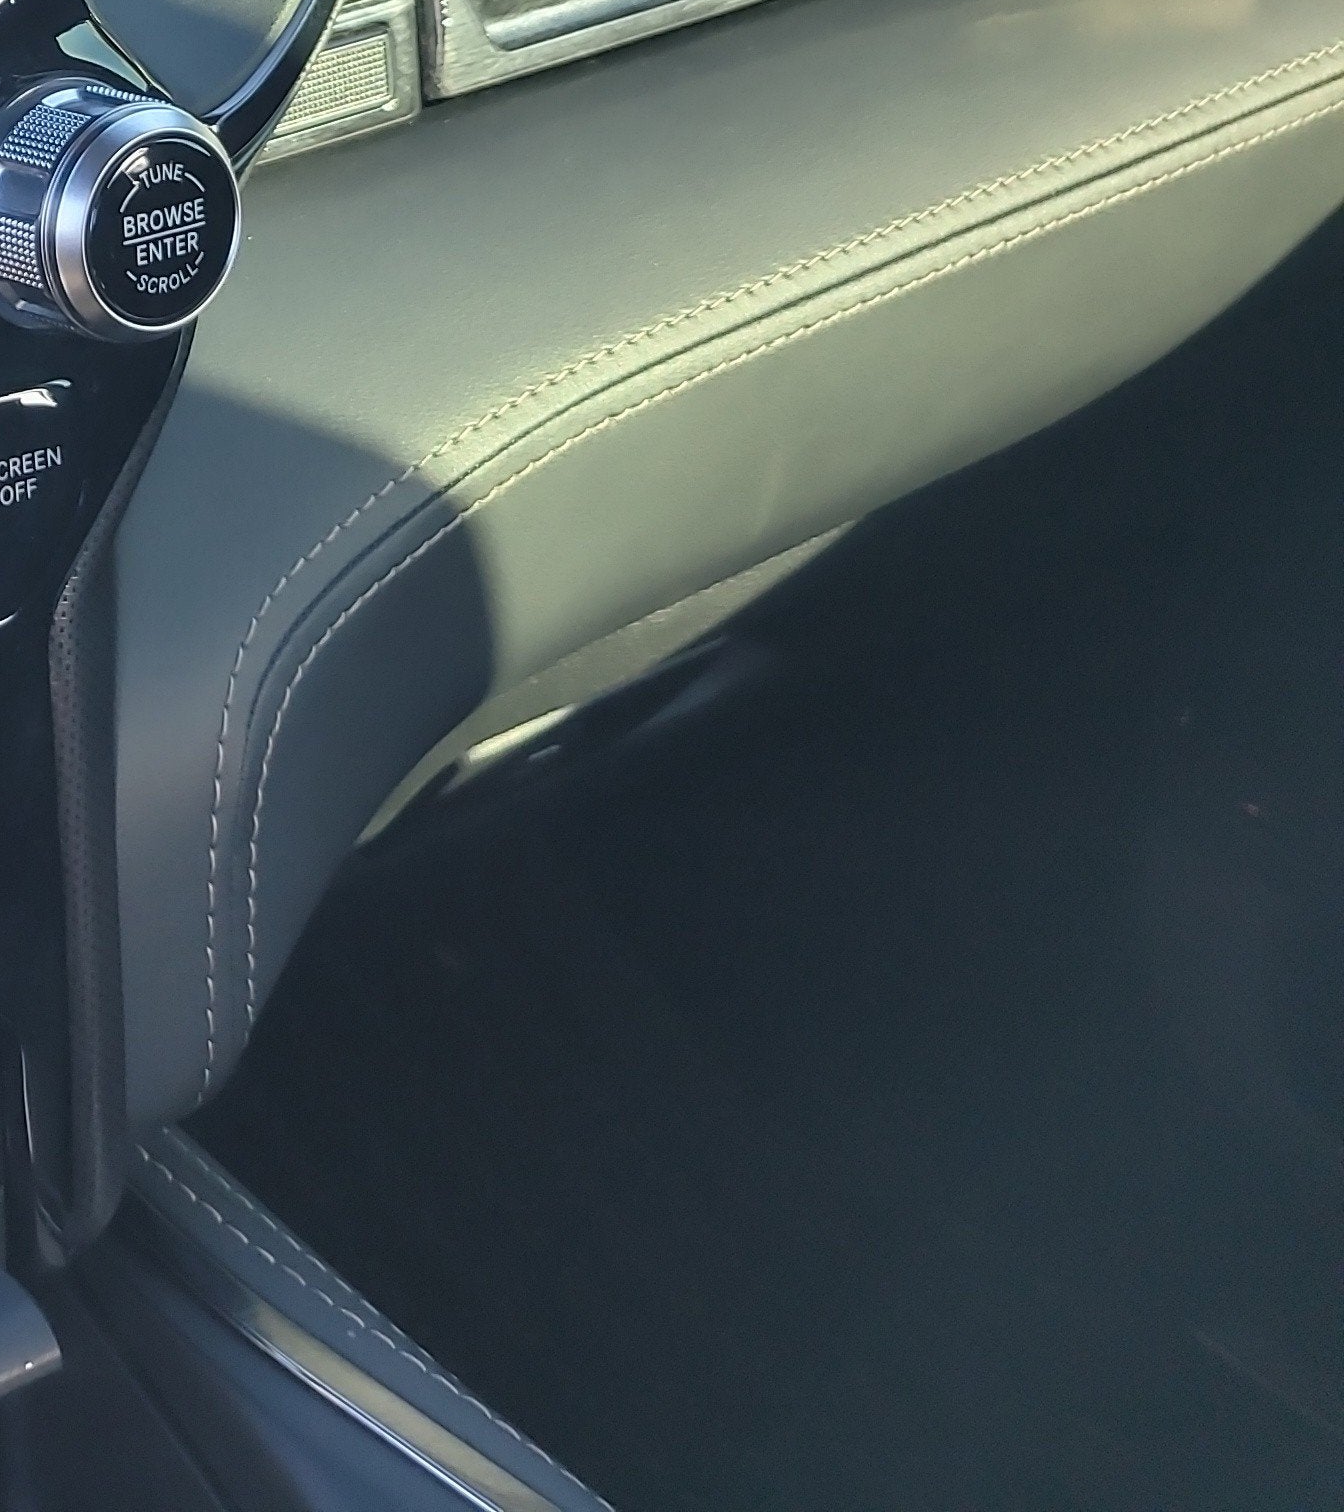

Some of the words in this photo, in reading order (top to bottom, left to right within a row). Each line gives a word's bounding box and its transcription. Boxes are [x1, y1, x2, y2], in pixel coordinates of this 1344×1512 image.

[139, 163, 184, 189] TUNE
[123, 198, 205, 238] BROWSE
[136, 231, 199, 266] ENTER
[137, 262, 199, 294] SCROLL
[0, 478, 38, 507] OFF
